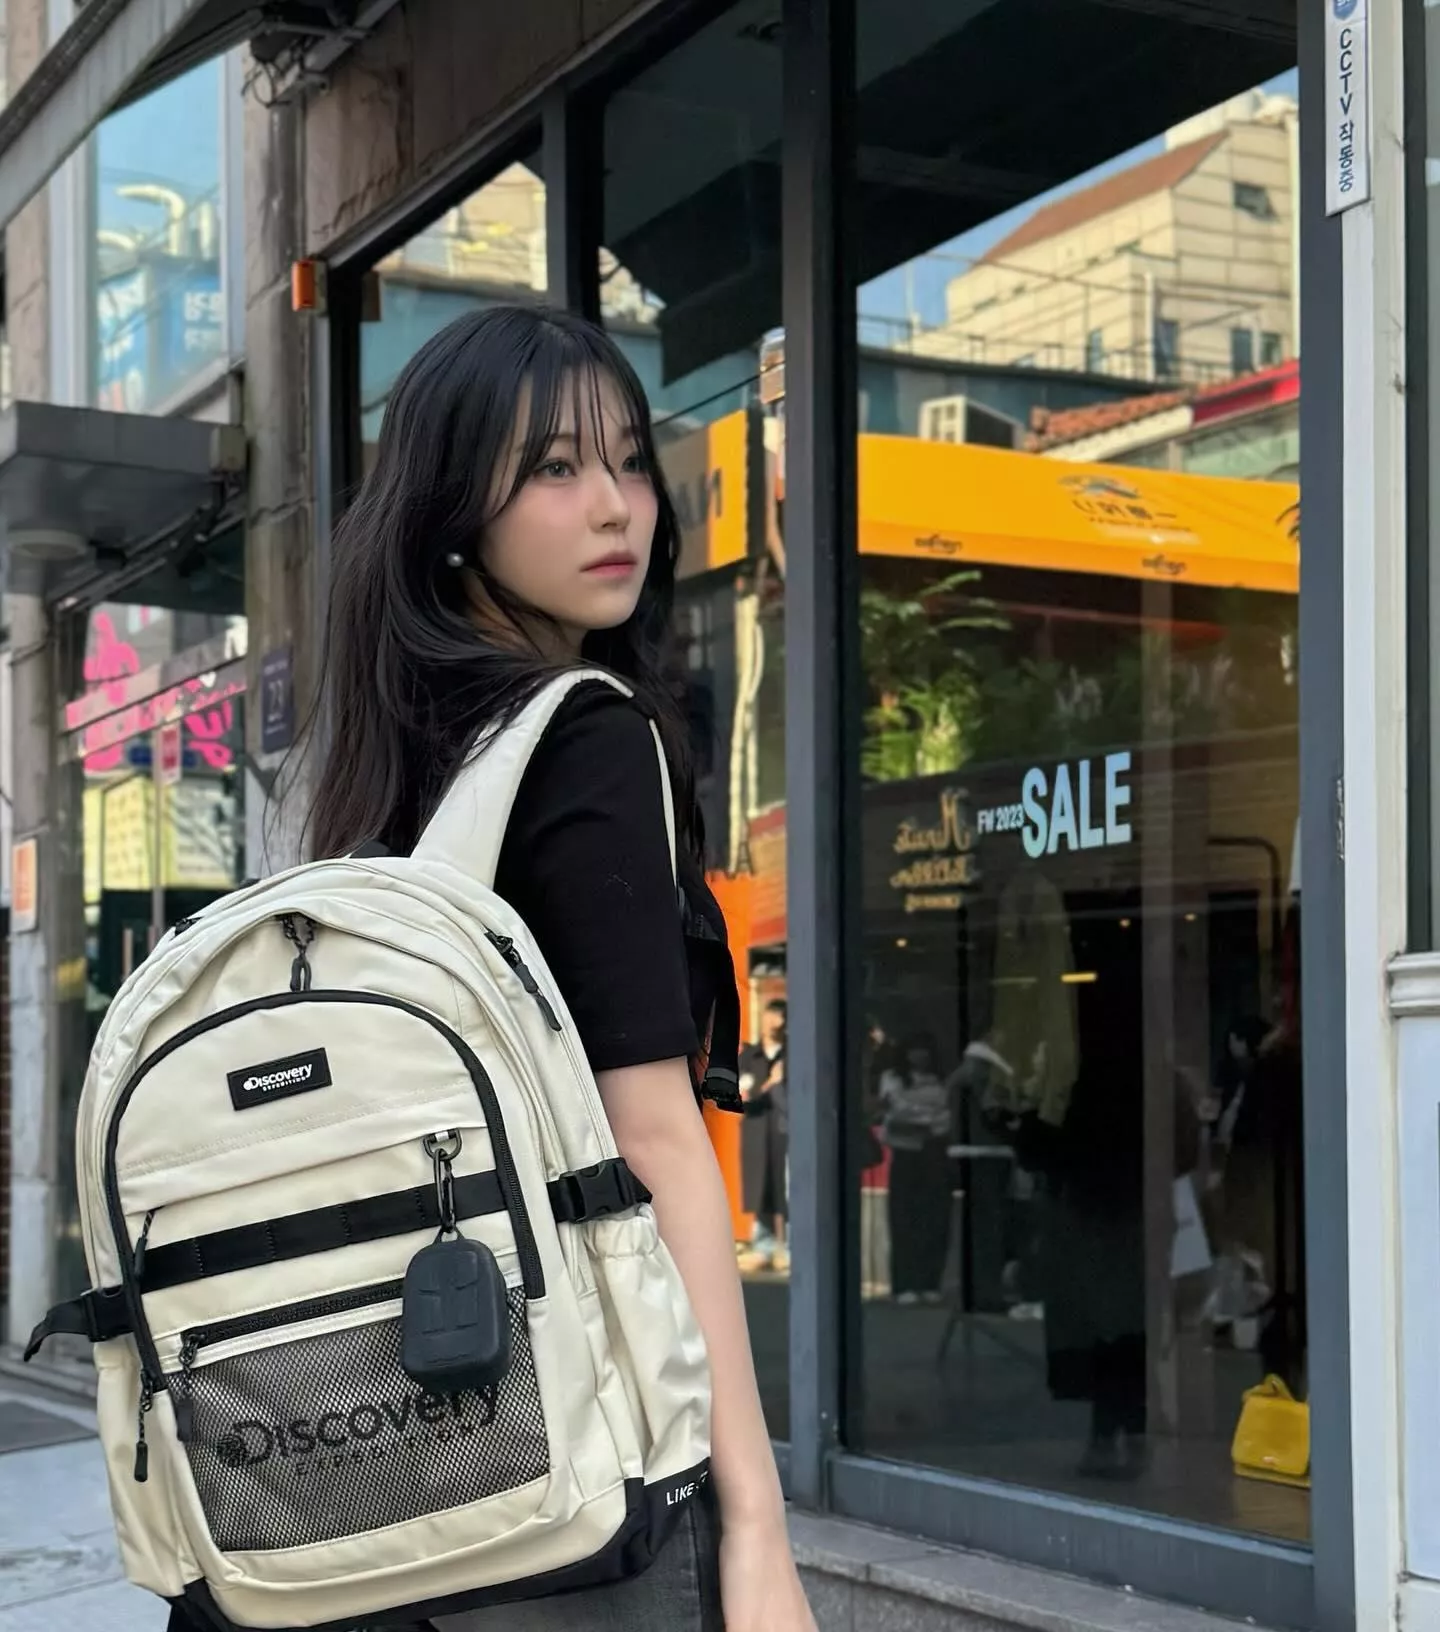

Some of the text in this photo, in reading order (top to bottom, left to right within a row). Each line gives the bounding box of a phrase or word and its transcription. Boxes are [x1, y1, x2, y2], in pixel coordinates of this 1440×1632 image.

[1338, 27, 1355, 193] CCTV 작동중
[976, 808, 995, 835] FW
[996, 804, 1023, 829] 2023
[1022, 751, 1132, 859] SALE
